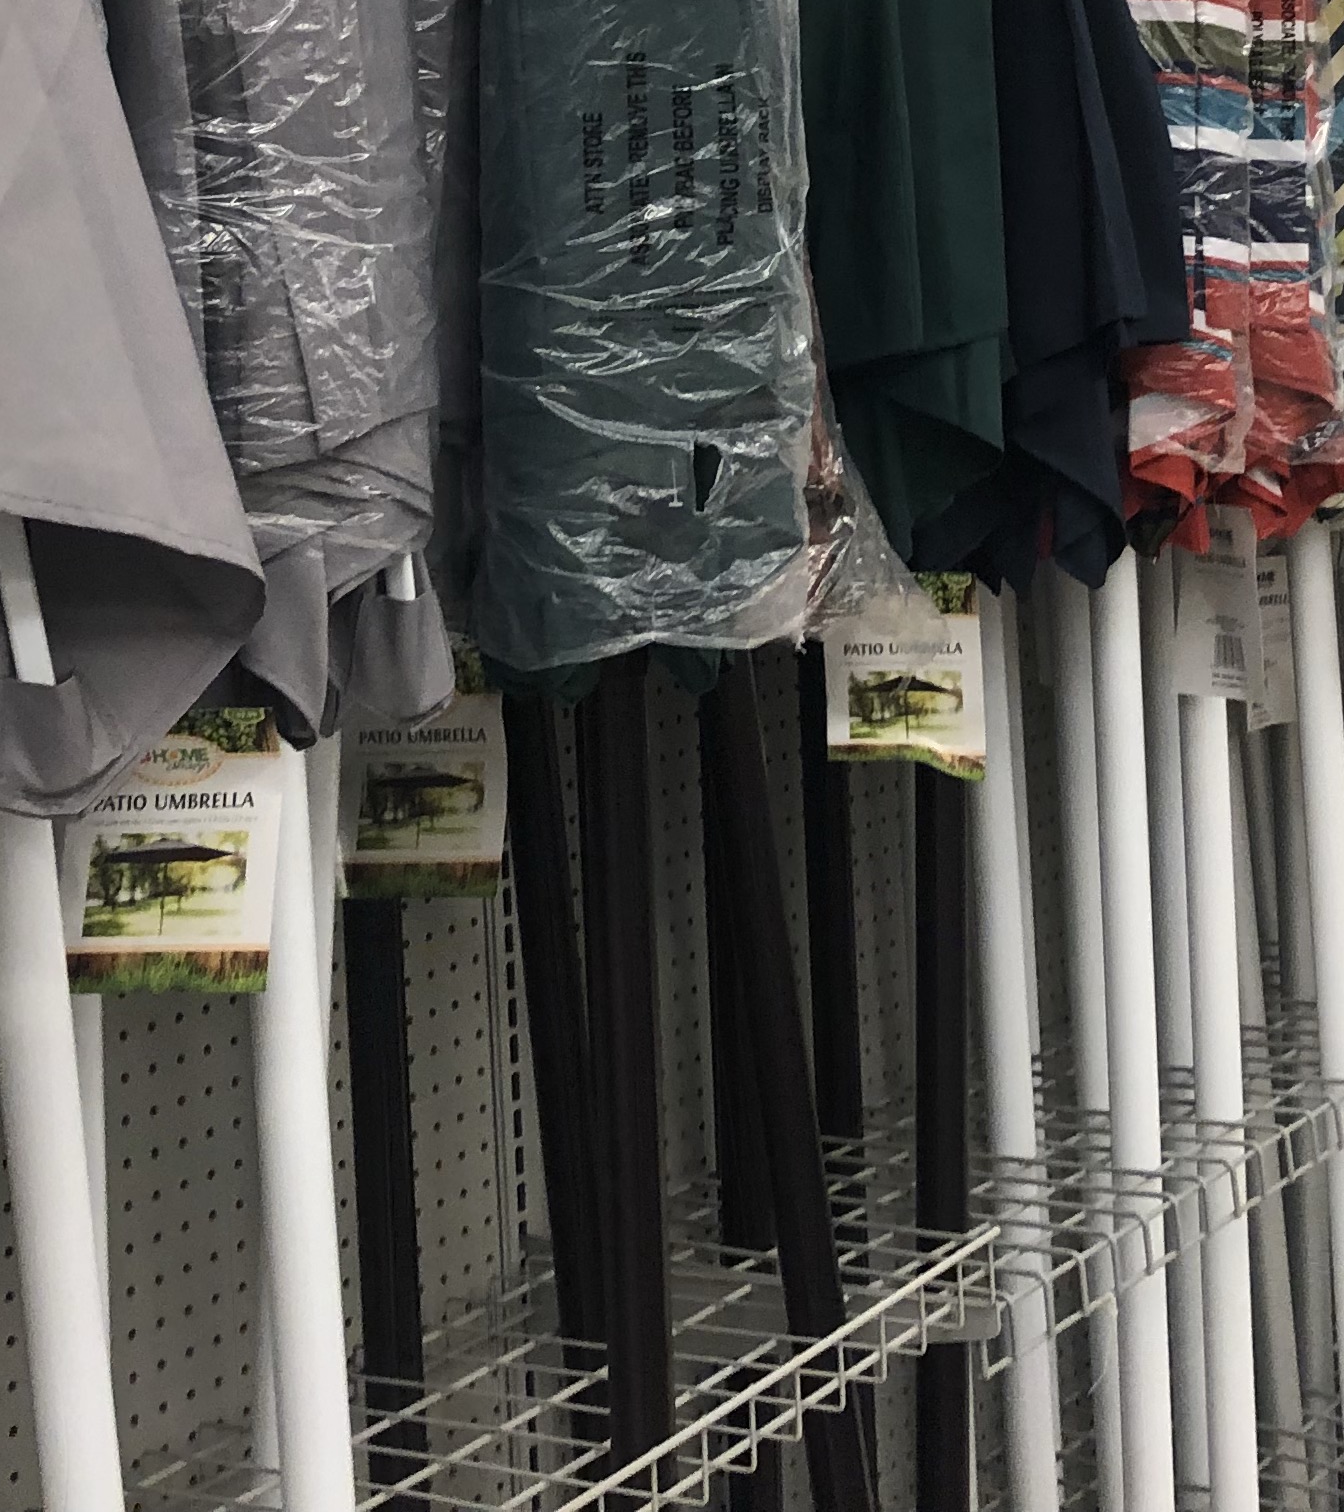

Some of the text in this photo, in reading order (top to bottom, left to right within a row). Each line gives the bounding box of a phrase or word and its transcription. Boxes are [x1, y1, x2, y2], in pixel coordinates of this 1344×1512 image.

[756, 96, 773, 146] RACK
[582, 110, 604, 170] STORE
[843, 641, 885, 657] PATIO
[359, 726, 488, 746] PATIO UMBRELLA
[151, 747, 210, 765] HOME
[154, 790, 255, 812] UMBRELLA
